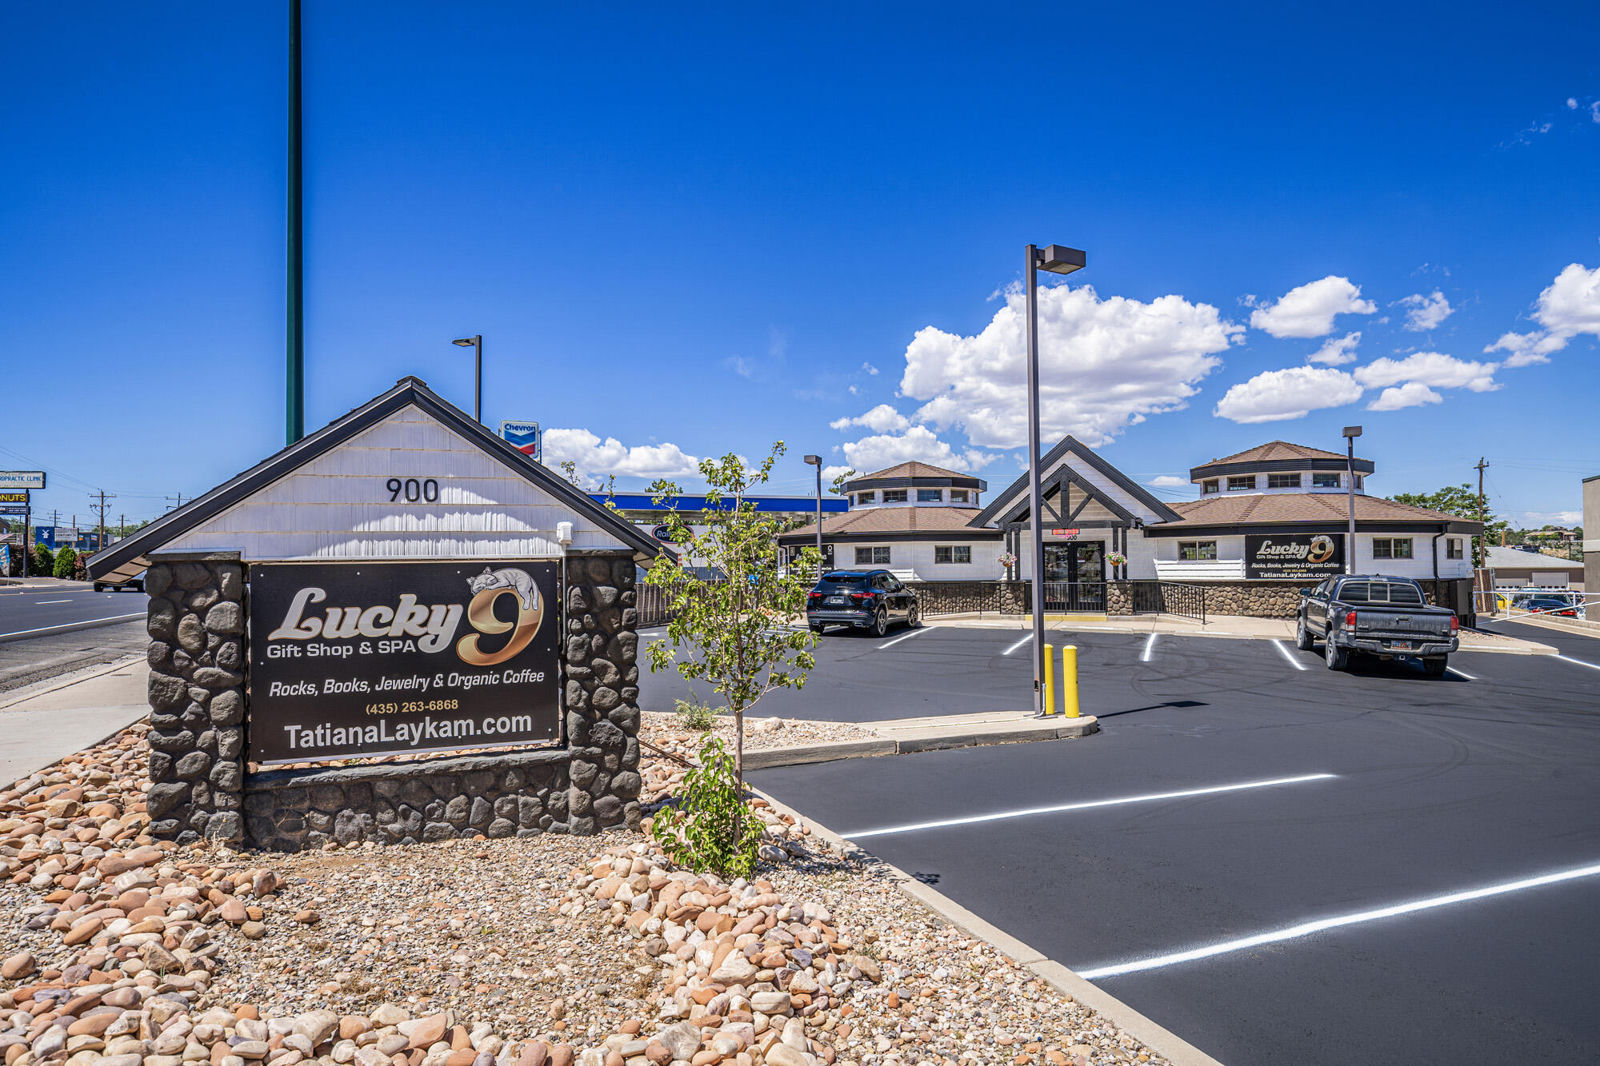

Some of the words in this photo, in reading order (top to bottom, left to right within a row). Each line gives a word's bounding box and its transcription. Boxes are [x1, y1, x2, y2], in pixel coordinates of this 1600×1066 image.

[504, 423, 536, 431] Chevron
[386, 478, 439, 502] 900
[1256, 541, 1309, 559] Lucky
[1307, 536, 1335, 563] 9
[267, 587, 464, 653] Lucky
[457, 585, 545, 666] 9
[266, 644, 302, 659] Gift
[306, 643, 353, 659] Shop
[359, 641, 374, 655] &
[378, 639, 417, 654] SPA
[269, 680, 318, 697] Rocks,
[323, 677, 371, 694] Books,
[375, 674, 430, 692] Jewelry
[433, 673, 444, 688] &
[447, 671, 500, 690] Organic
[503, 668, 545, 684] Coffee
[365, 702, 398, 715] (435)
[401, 699, 459, 713] 263-6868
[284, 714, 532, 749] TatianaLaykam.com
